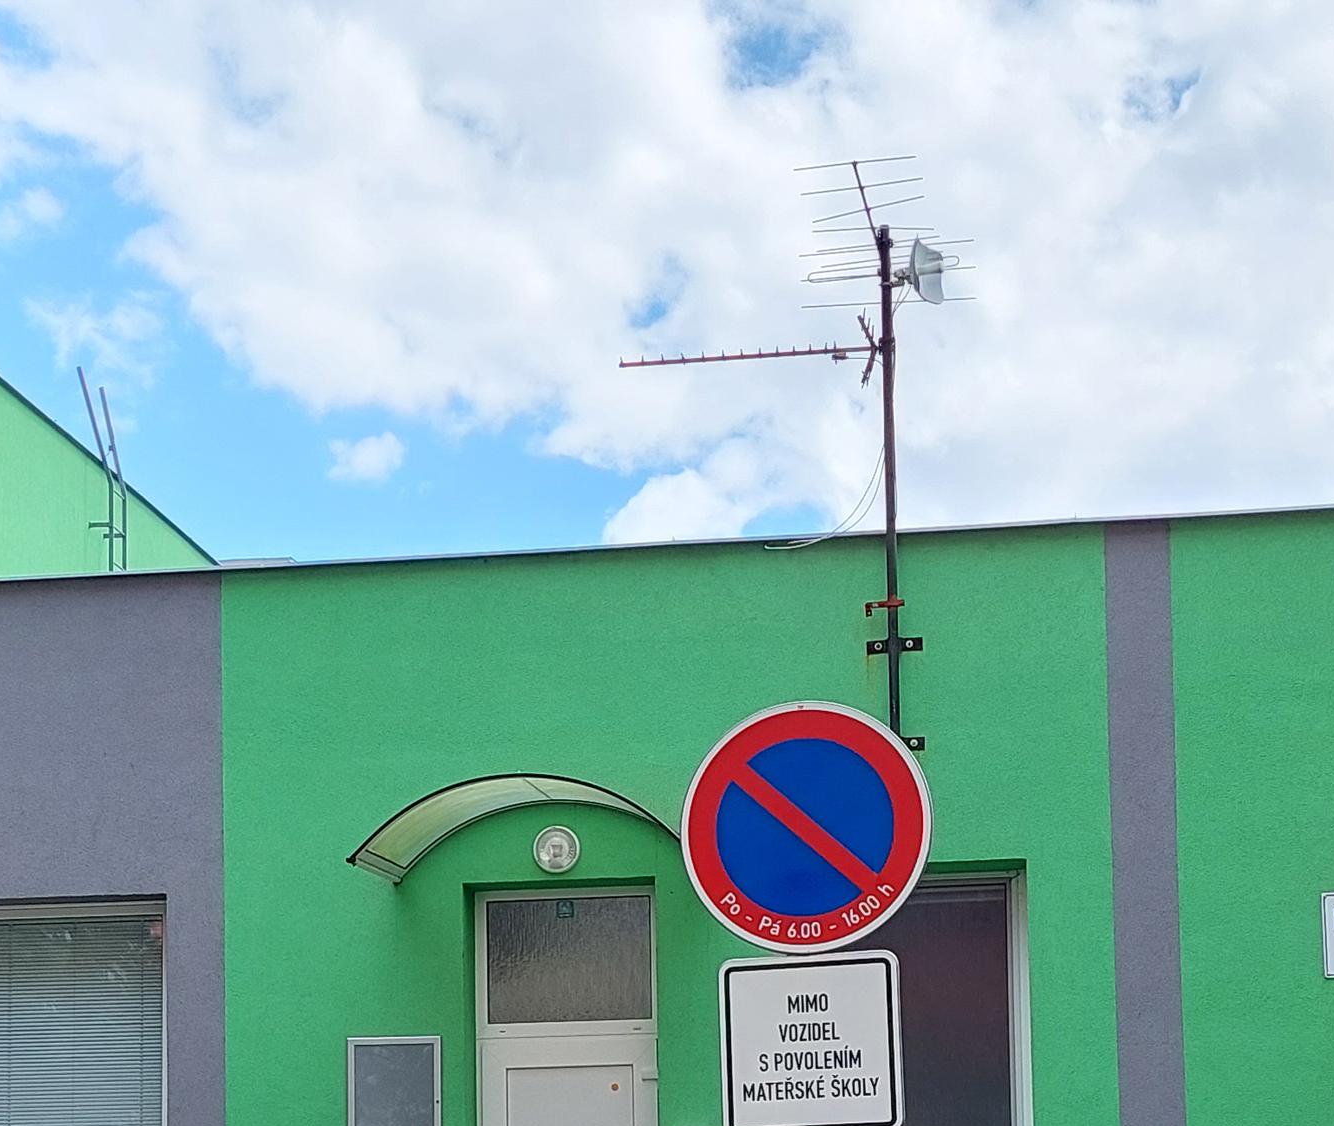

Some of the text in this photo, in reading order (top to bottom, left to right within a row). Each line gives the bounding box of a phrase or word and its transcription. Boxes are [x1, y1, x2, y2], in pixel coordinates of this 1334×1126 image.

[720, 892, 741, 915] Po
[758, 915, 781, 936] Pá
[787, 922, 821, 939] 6.00
[841, 895, 881, 927] 16.00
[877, 883, 895, 897] h
[787, 993, 829, 1014] MIMO
[778, 1022, 840, 1042] VOZIDEL
[759, 1045, 862, 1072] S POVOLENÍM
[743, 1075, 879, 1102] MATEŘSKÉ ŠKOLY
